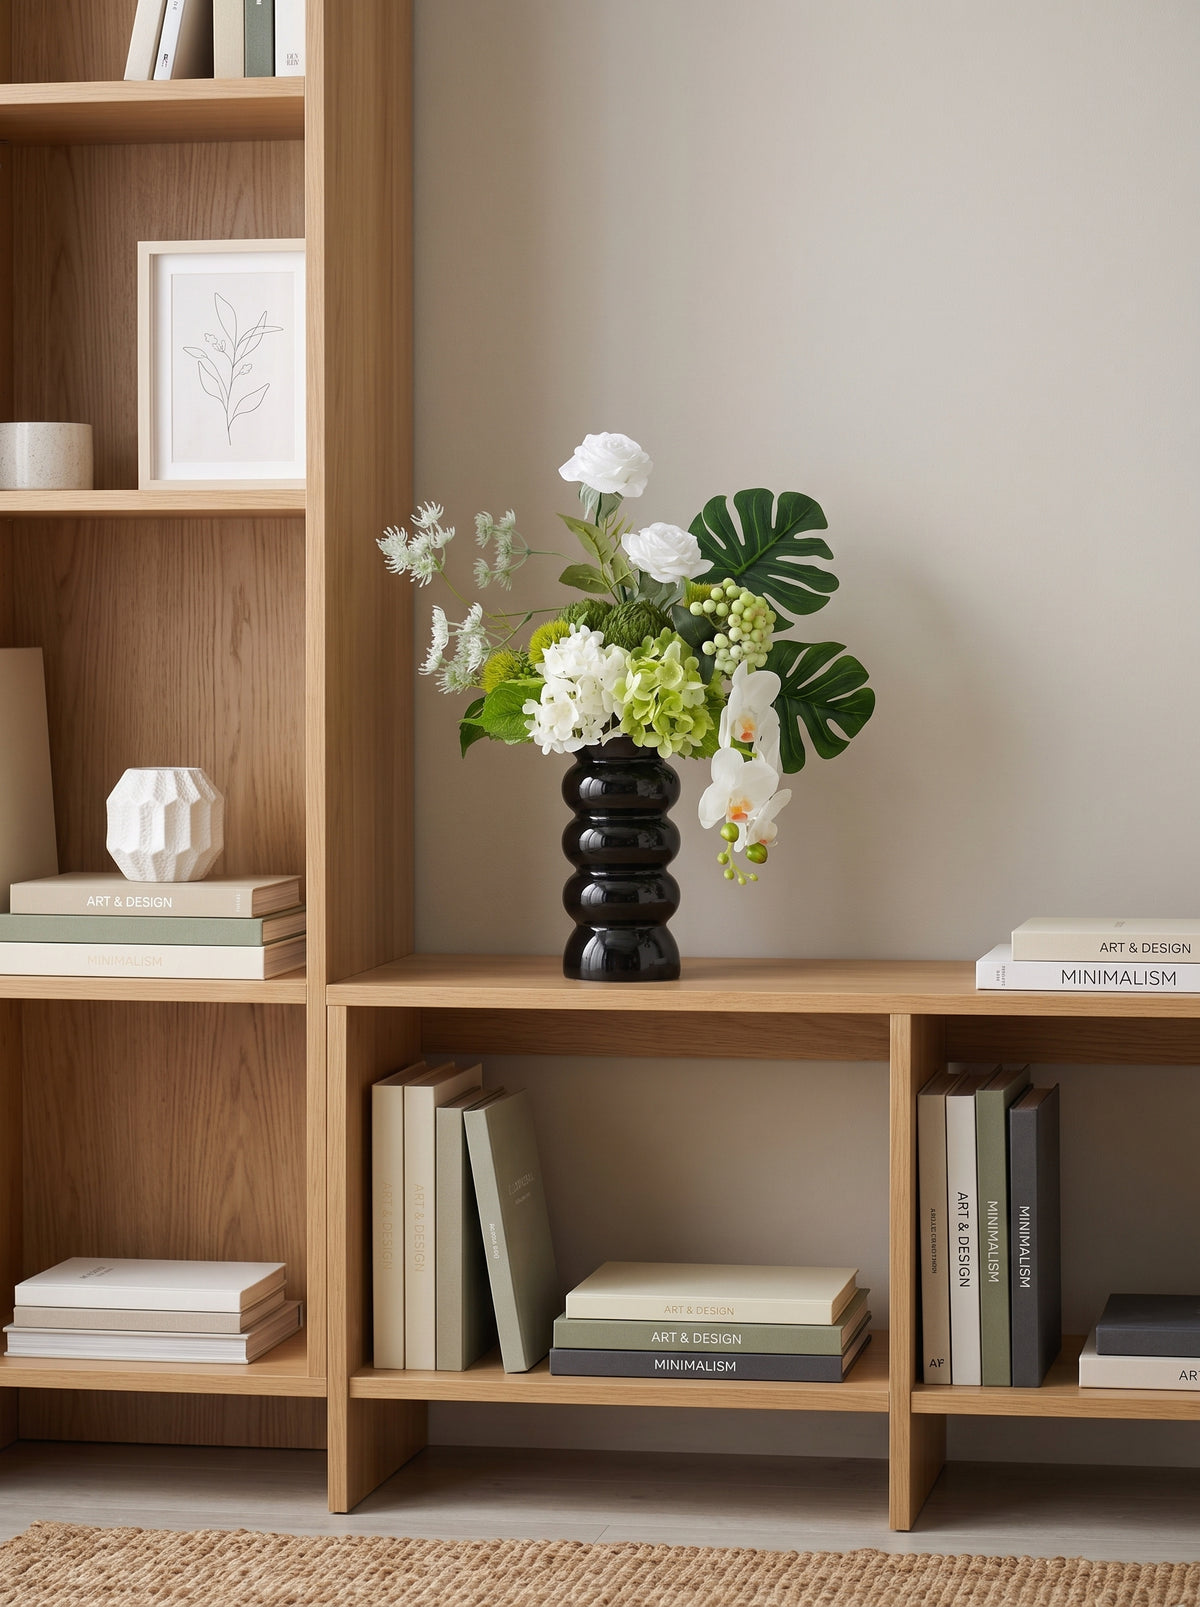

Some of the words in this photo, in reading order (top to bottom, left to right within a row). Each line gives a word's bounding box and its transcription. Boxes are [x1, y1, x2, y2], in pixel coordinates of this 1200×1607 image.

[86, 895, 111, 907] ART
[114, 896, 123, 908] &
[126, 896, 173, 909] DESIGN
[1100, 942, 1125, 953] ART
[1129, 942, 1138, 953] &
[1142, 943, 1191, 954] DESIGN
[87, 955, 163, 968] MINIMALISM
[1061, 969, 1177, 986] MINIMALISM
[383, 1183, 392, 1206] ART
[414, 1184, 424, 1207] ART
[957, 1192, 969, 1218] ART
[383, 1208, 392, 1218] &
[415, 1210, 424, 1221] &
[958, 1223, 970, 1231] &
[383, 1221, 393, 1271] DESIGN
[415, 1225, 425, 1273] DESIGN
[987, 1201, 999, 1283] MINIMALISM
[1019, 1206, 1031, 1288] MINIMALISM
[958, 1236, 970, 1287] DESIGN
[664, 1305, 683, 1314] ART
[687, 1306, 694, 1315] &
[696, 1306, 735, 1316] DESIGN
[651, 1332, 677, 1343] ART
[680, 1333, 689, 1344] &
[693, 1334, 742, 1345] DESIGN
[654, 1359, 737, 1373] MINIMALISM
